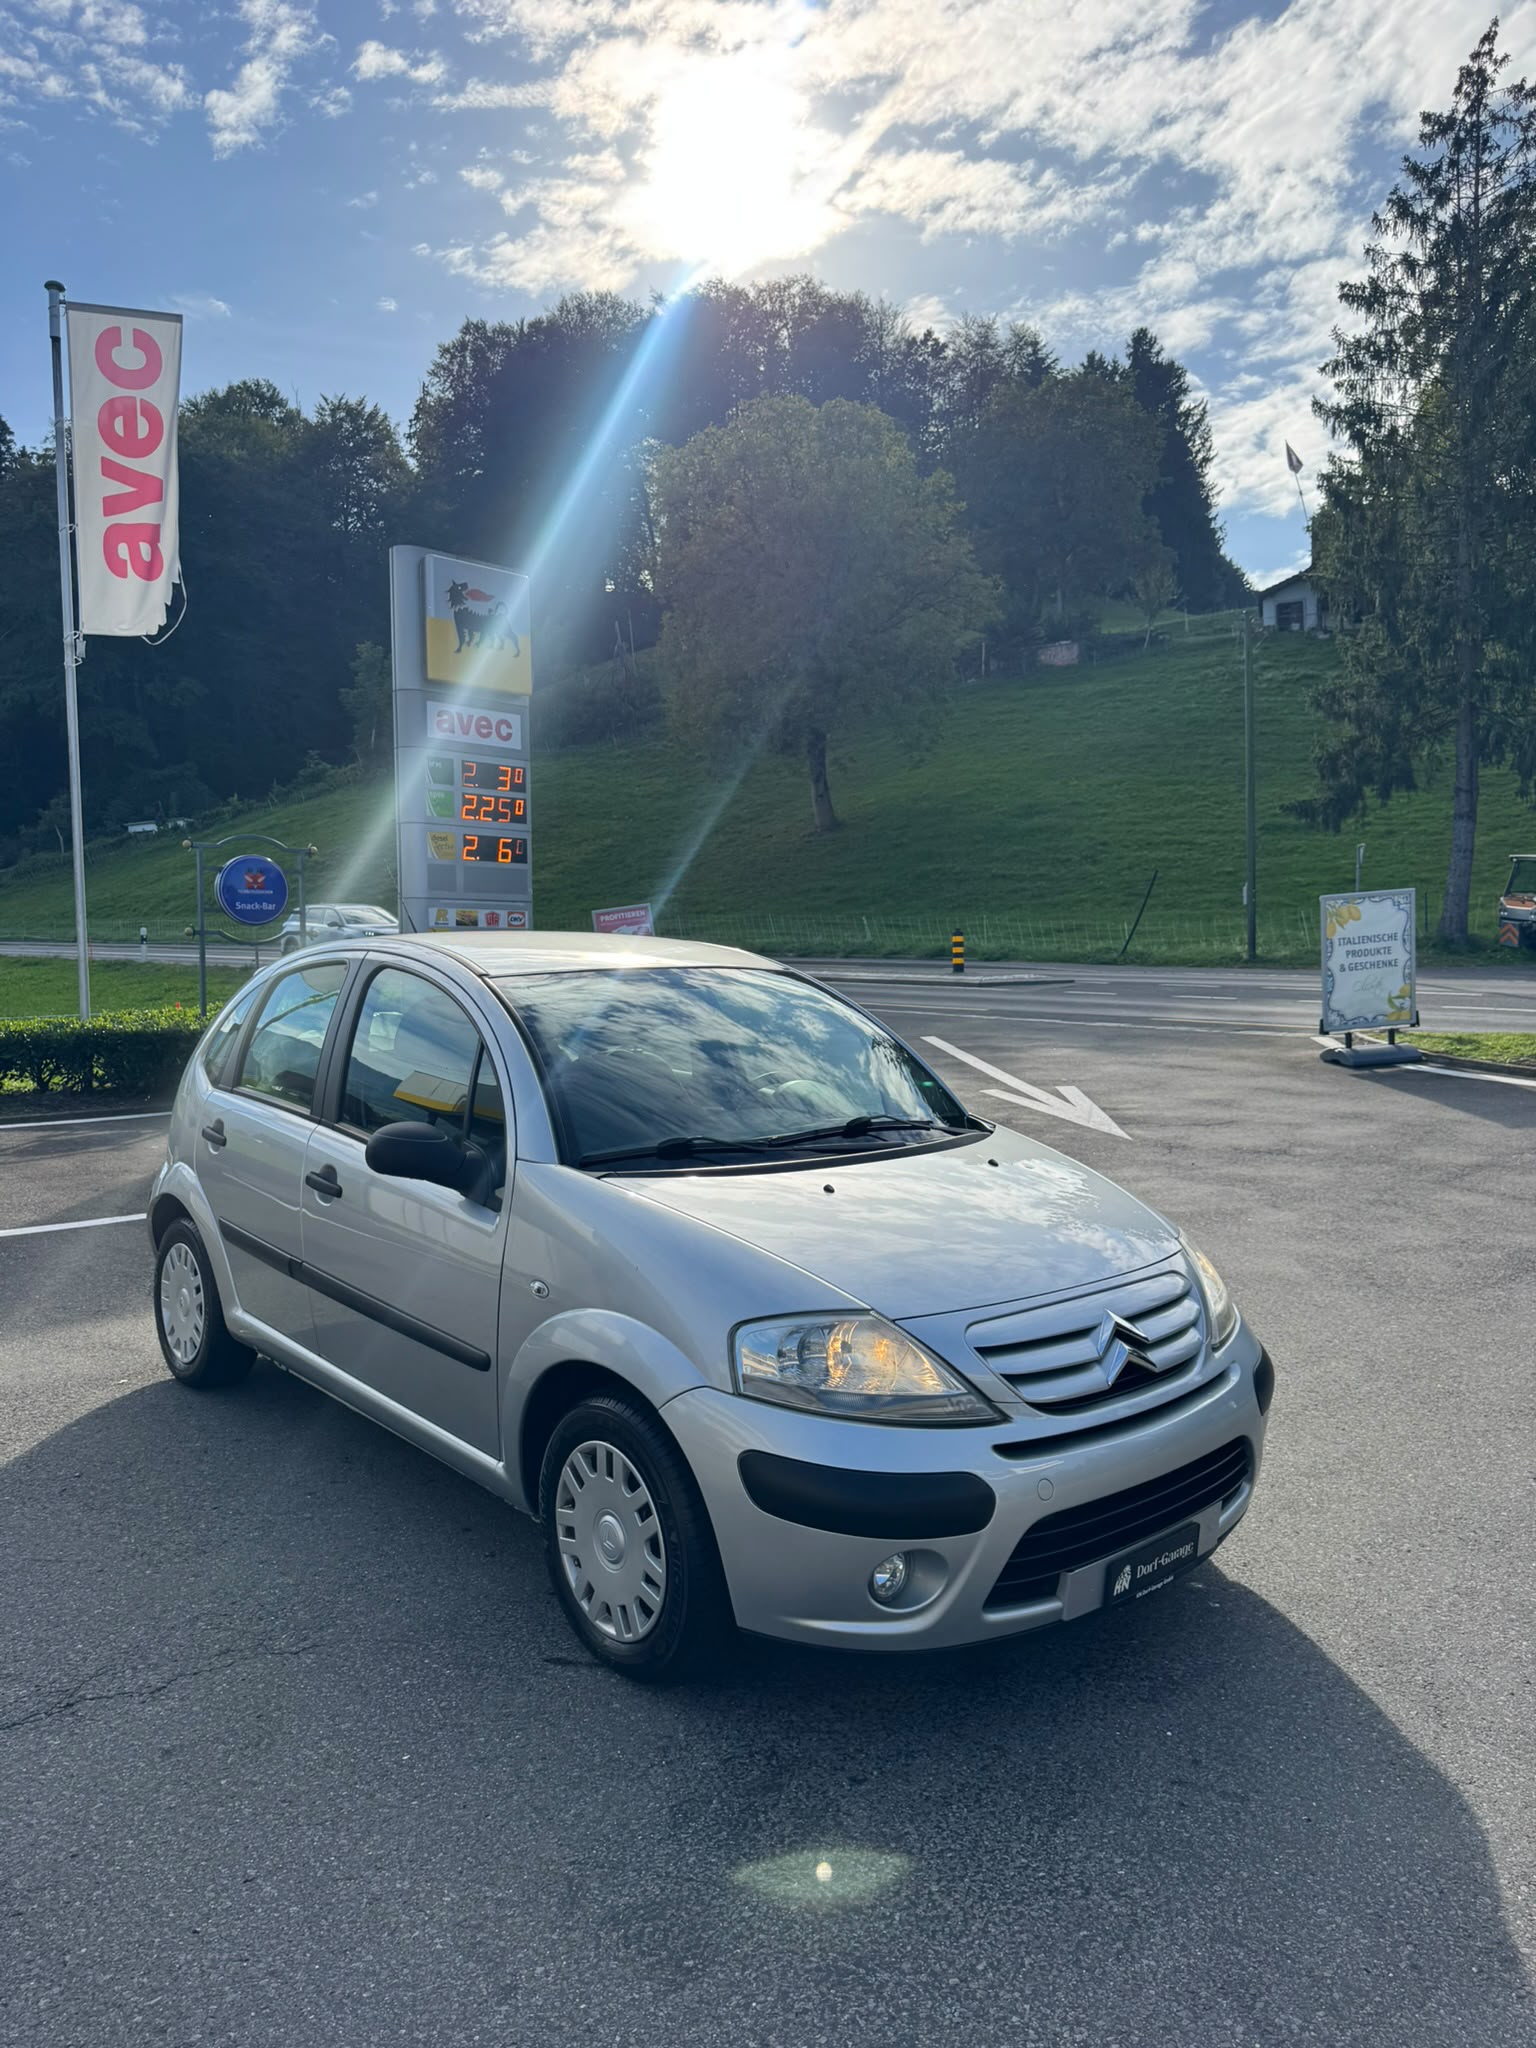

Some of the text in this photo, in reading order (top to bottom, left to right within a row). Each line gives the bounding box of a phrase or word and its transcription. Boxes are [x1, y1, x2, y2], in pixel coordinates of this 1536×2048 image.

[95, 326, 164, 582] avec
[435, 709, 513, 742] avec
[235, 901, 276, 910] Snack-Bar
[1338, 932, 1399, 946] ITALIENISCHE
[1345, 946, 1392, 959] PRODUKTE
[1339, 958, 1399, 973] & GESCHENKE
[1136, 1542, 1195, 1579] Dorf-Garage
